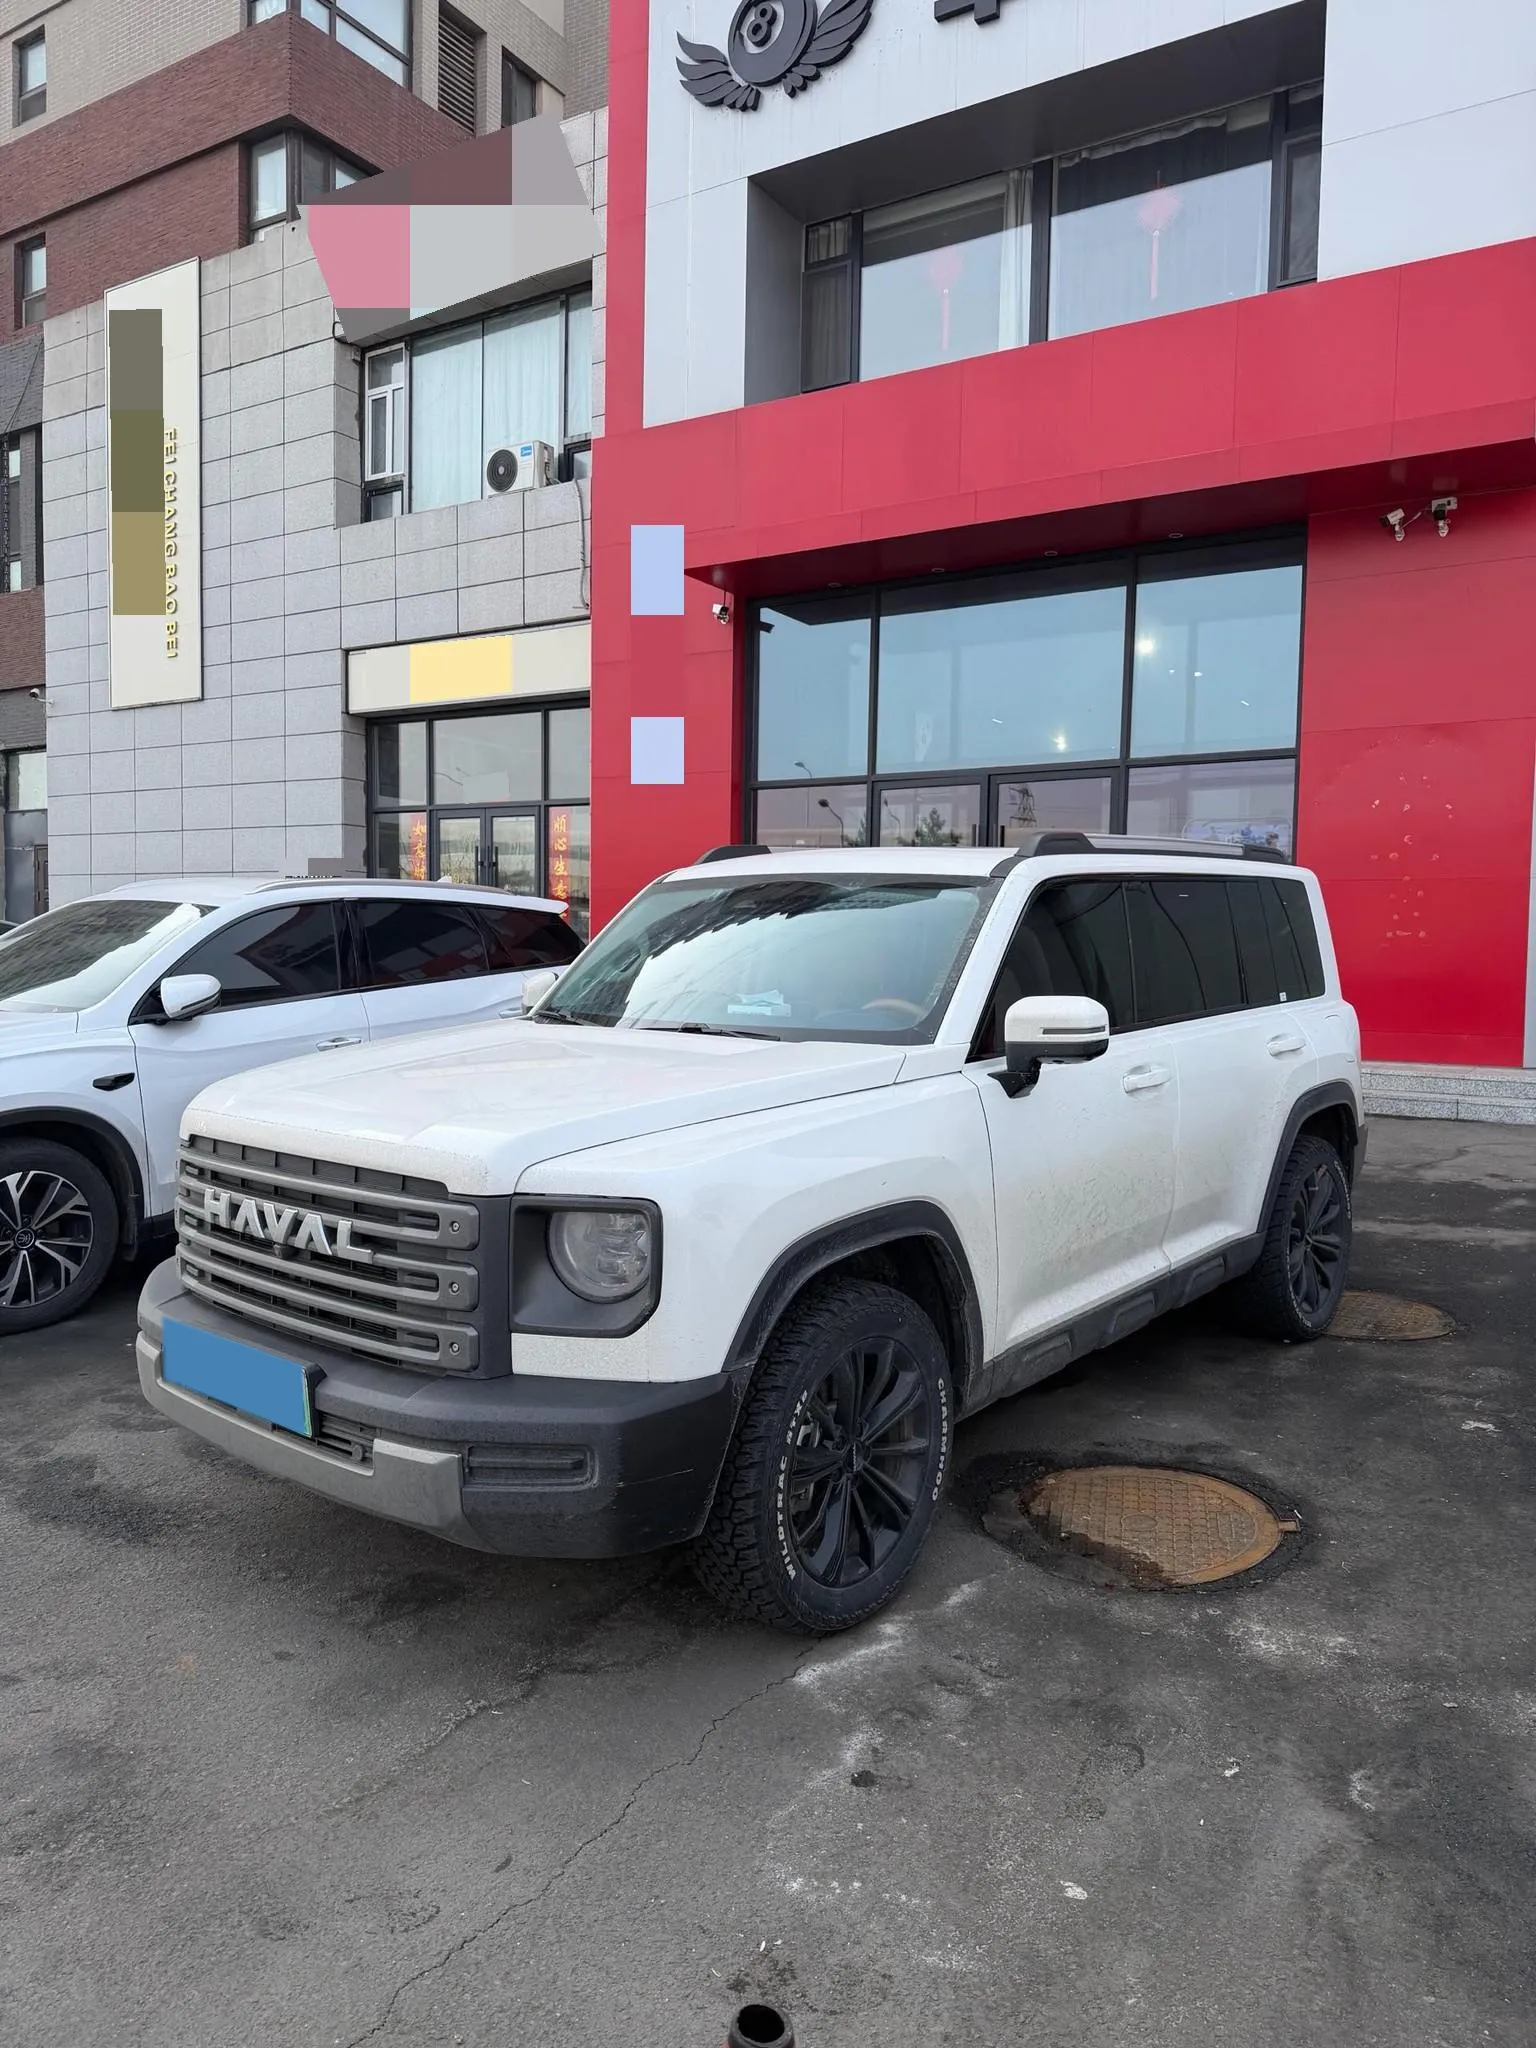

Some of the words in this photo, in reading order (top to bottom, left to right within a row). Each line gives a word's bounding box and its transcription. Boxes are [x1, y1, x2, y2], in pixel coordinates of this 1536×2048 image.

[747, 2, 777, 47] 8
[164, 428, 177, 465] FEI
[164, 471, 178, 558] CHANG
[165, 564, 178, 615] BAO
[166, 620, 178, 658] BEI
[204, 1188, 373, 1264] HAVAL
[777, 1456, 796, 1581] WILDTRAC
